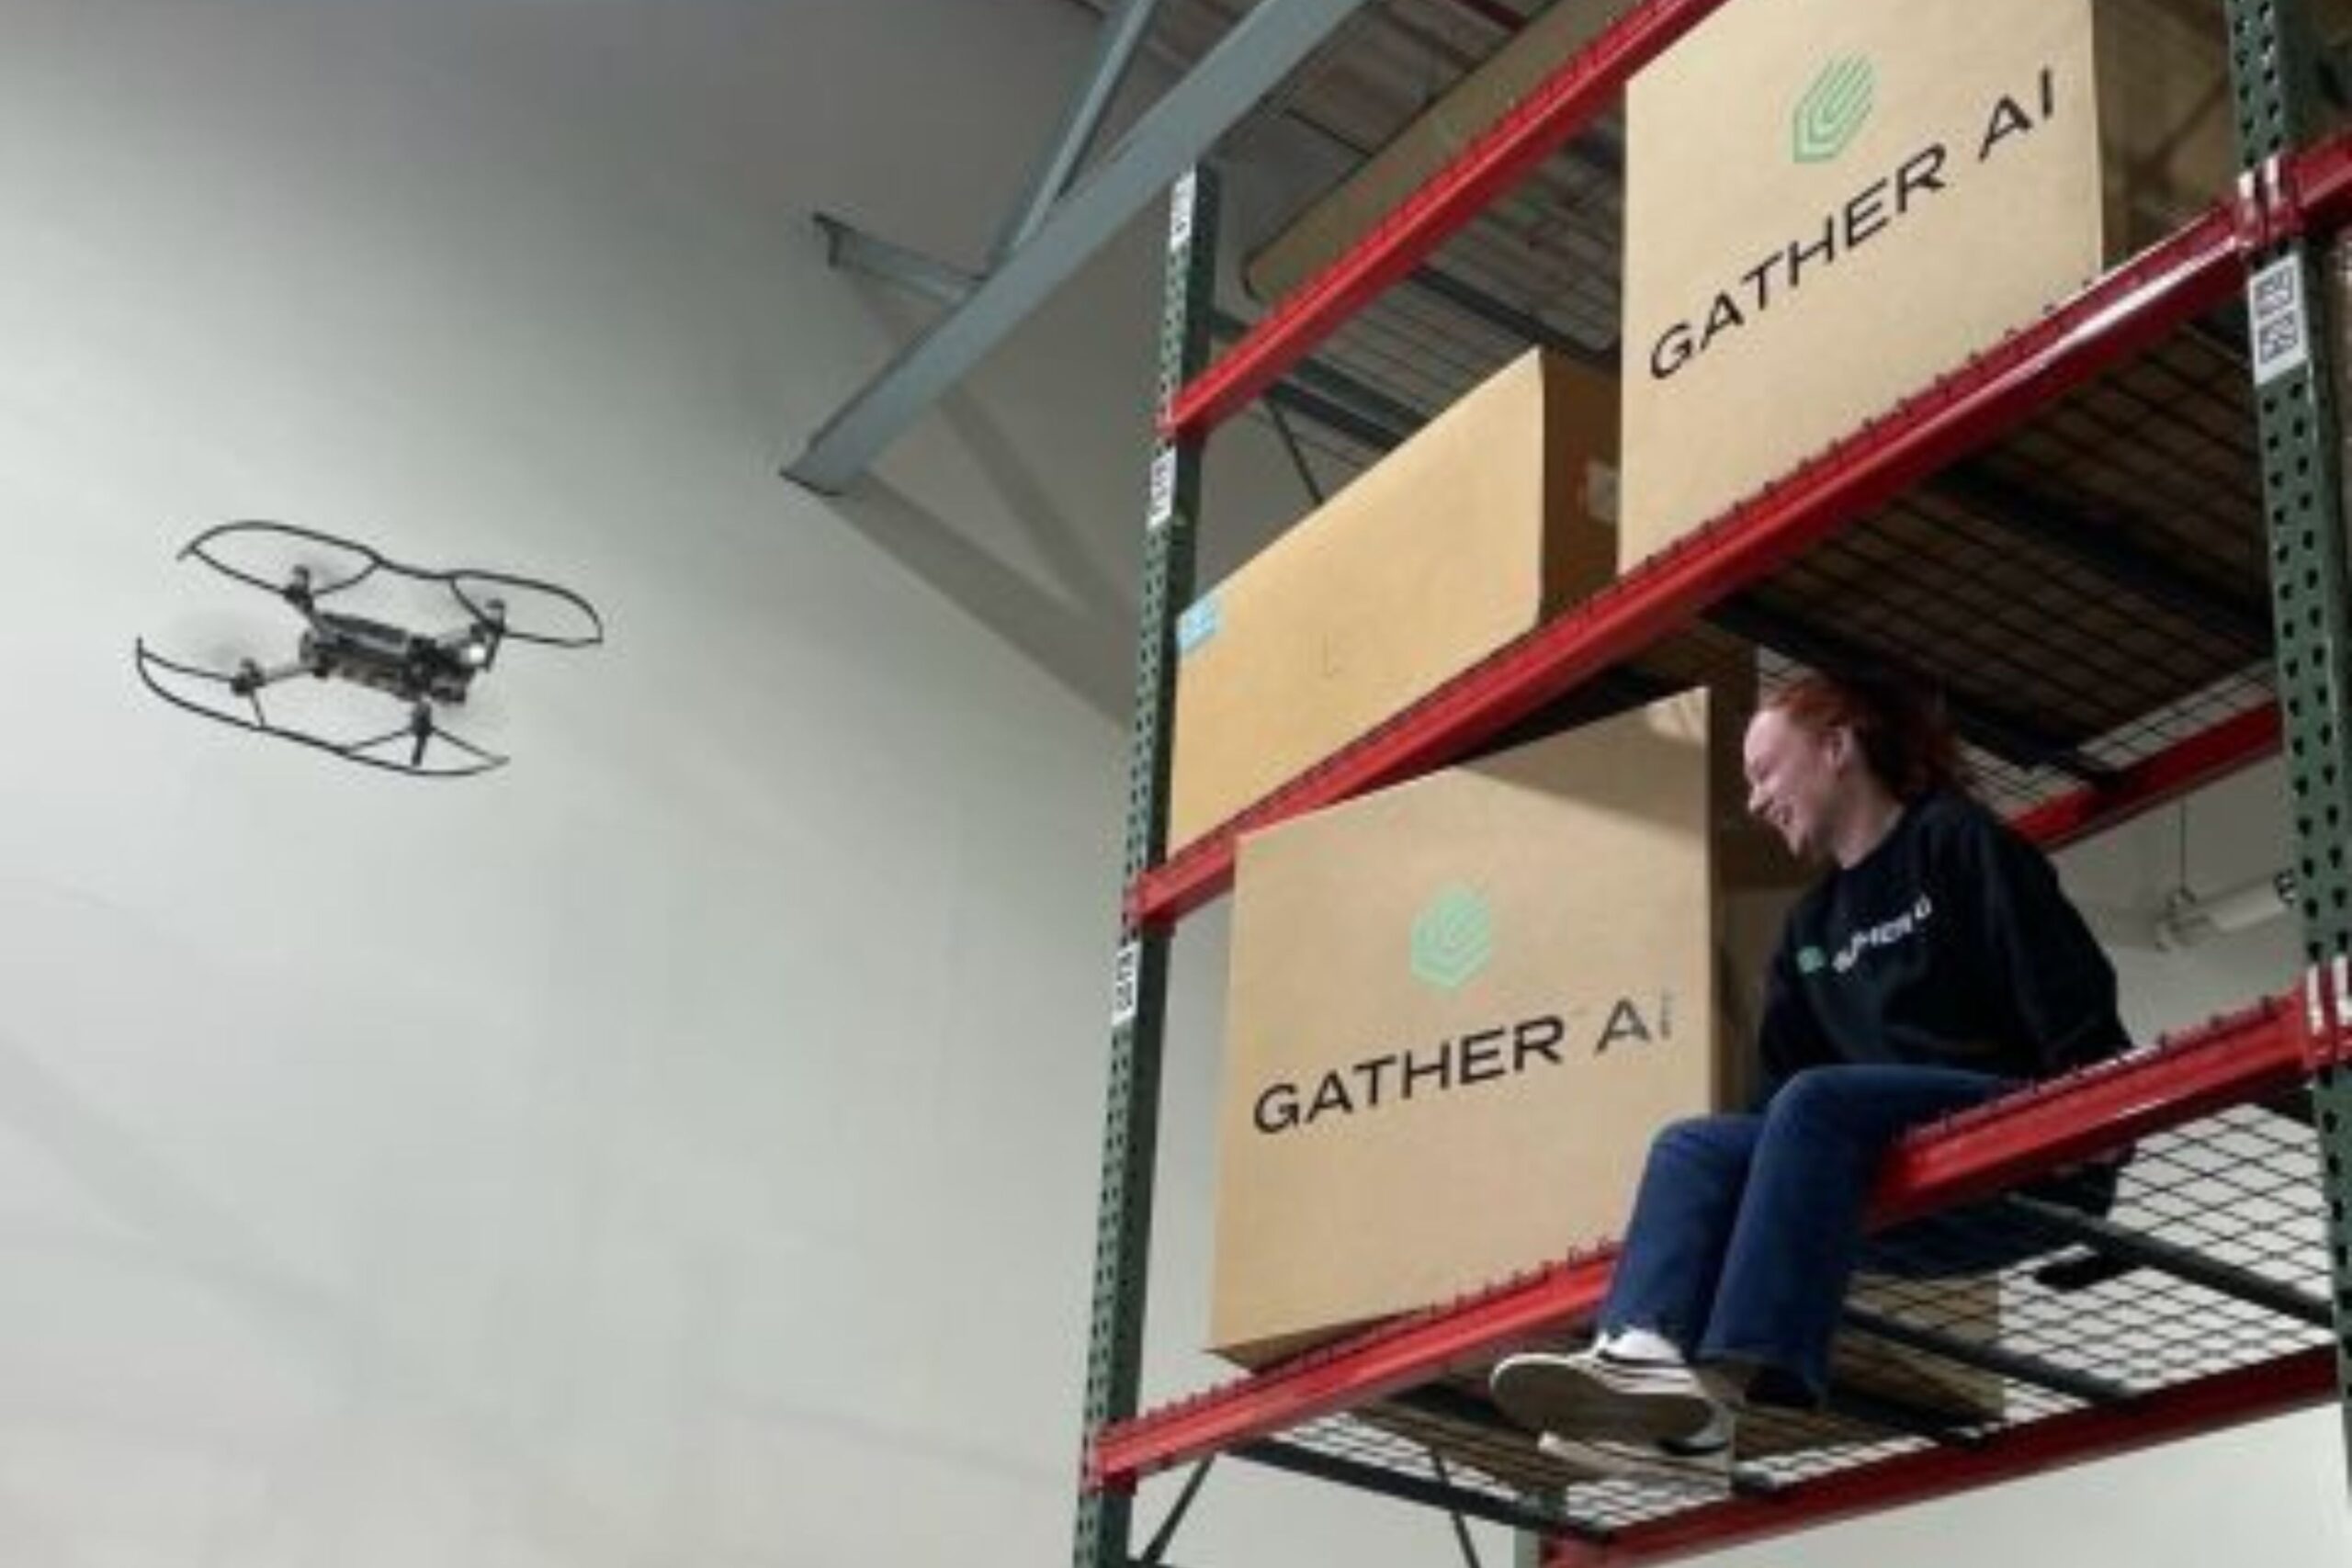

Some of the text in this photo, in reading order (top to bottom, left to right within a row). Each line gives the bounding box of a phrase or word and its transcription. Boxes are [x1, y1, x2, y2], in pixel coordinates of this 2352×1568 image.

[1650, 68, 2053, 380] GATHER AI
[1253, 1014, 1565, 1134] GATHER
